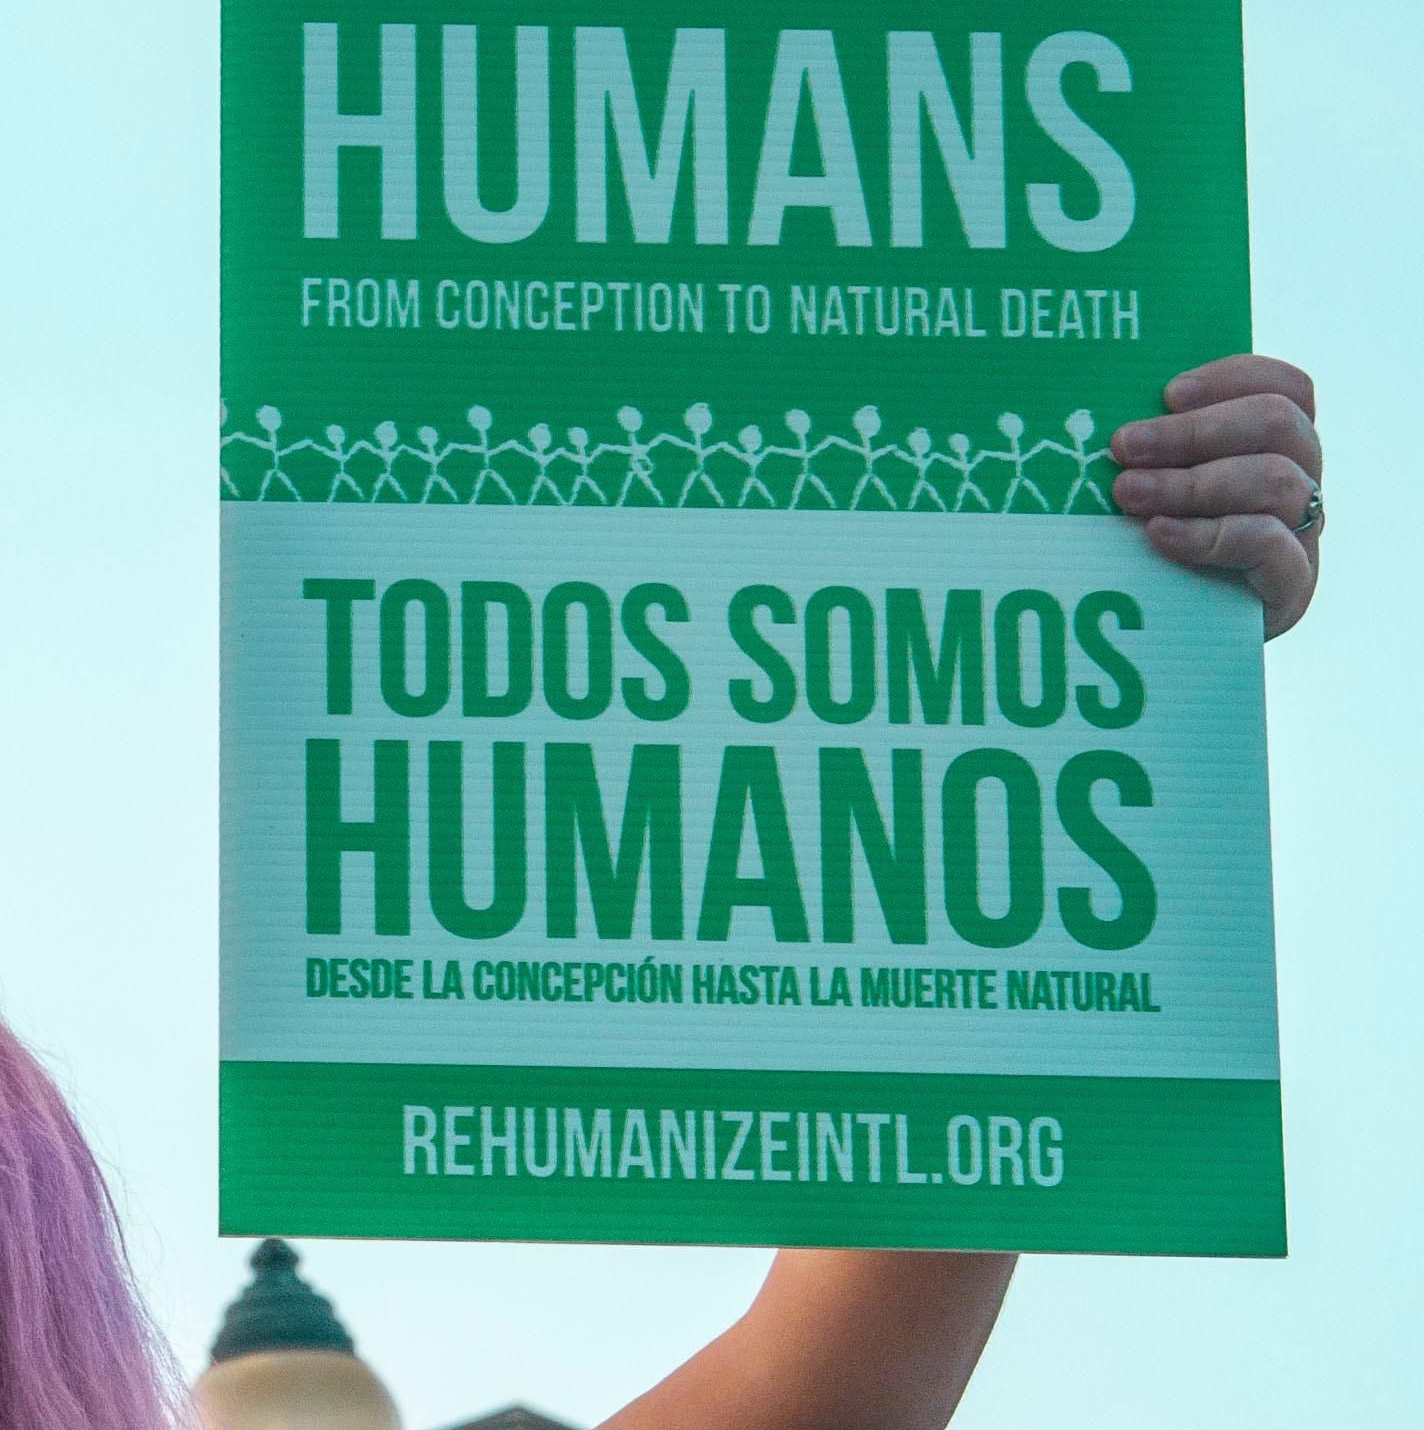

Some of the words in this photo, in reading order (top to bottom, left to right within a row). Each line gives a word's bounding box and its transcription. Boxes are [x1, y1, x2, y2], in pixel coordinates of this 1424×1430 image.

[303, 22, 1136, 253] HUMANS
[301, 277, 420, 329] FROM
[435, 278, 704, 334] CONCEPTION
[717, 283, 772, 335] TO
[790, 284, 987, 339] NATURAL
[1000, 287, 1141, 341] DEATH
[301, 577, 691, 722] TODOS
[727, 584, 1148, 731] SOMOS
[304, 737, 1160, 952] HUMANOS
[305, 957, 414, 1001] DESDE
[421, 959, 466, 1001] LA
[471, 955, 683, 1005] CONCEPCIÓN
[691, 964, 801, 1007] HASTA
[808, 966, 853, 1008] LA
[859, 966, 999, 1011] MUERTE
[1005, 969, 1163, 1014] NATURAL
[402, 1104, 1065, 1188] REHUMANIZEINTL.ORG
